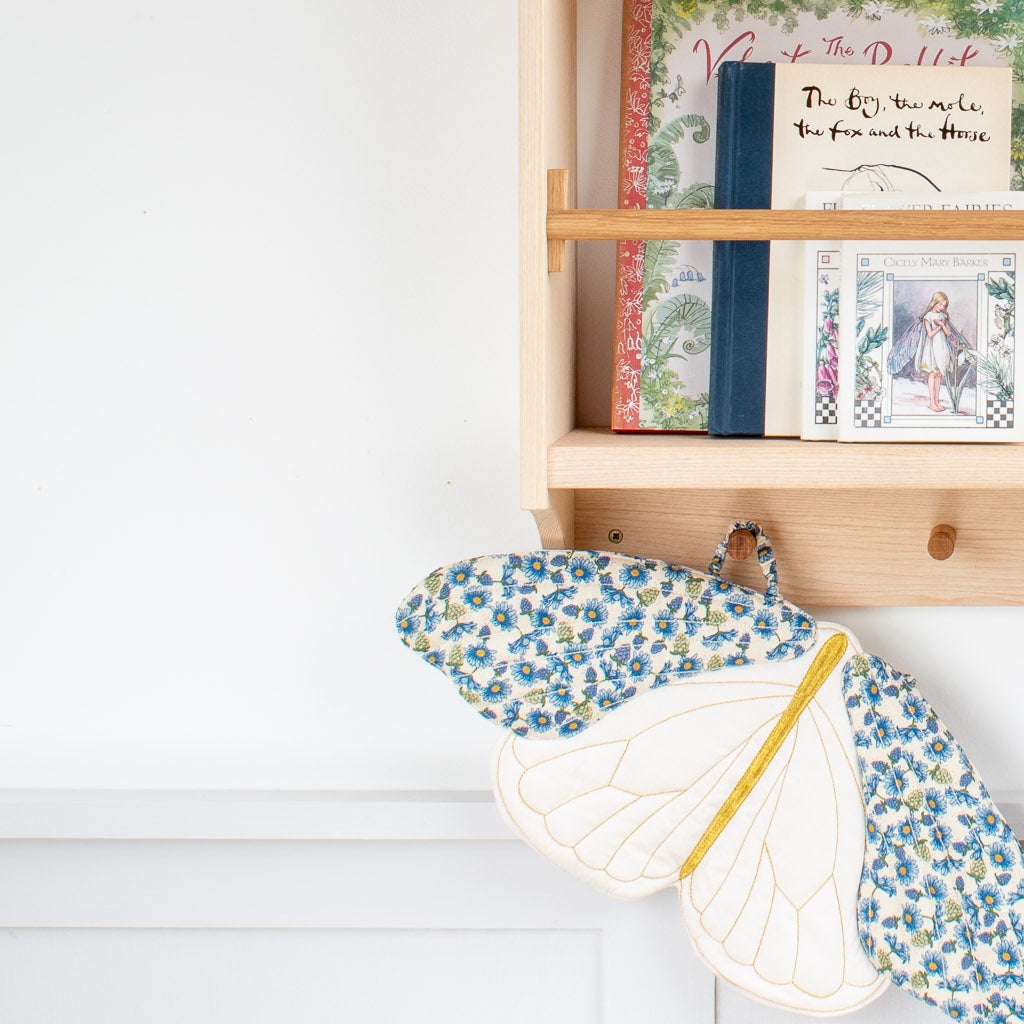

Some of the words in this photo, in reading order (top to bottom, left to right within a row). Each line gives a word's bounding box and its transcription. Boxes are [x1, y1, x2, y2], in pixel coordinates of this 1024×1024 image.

[822, 36, 854, 57] The
[801, 86, 837, 108] The
[845, 86, 886, 118] Boy,
[889, 93, 923, 110] the
[793, 119, 824, 138] the
[829, 119, 863, 142] fox
[869, 125, 901, 139] and
[905, 121, 935, 139] the
[938, 113, 991, 142] Horse
[883, 256, 919, 267] CICELY
[921, 256, 951, 267] MARY
[953, 257, 989, 267] BARKER
